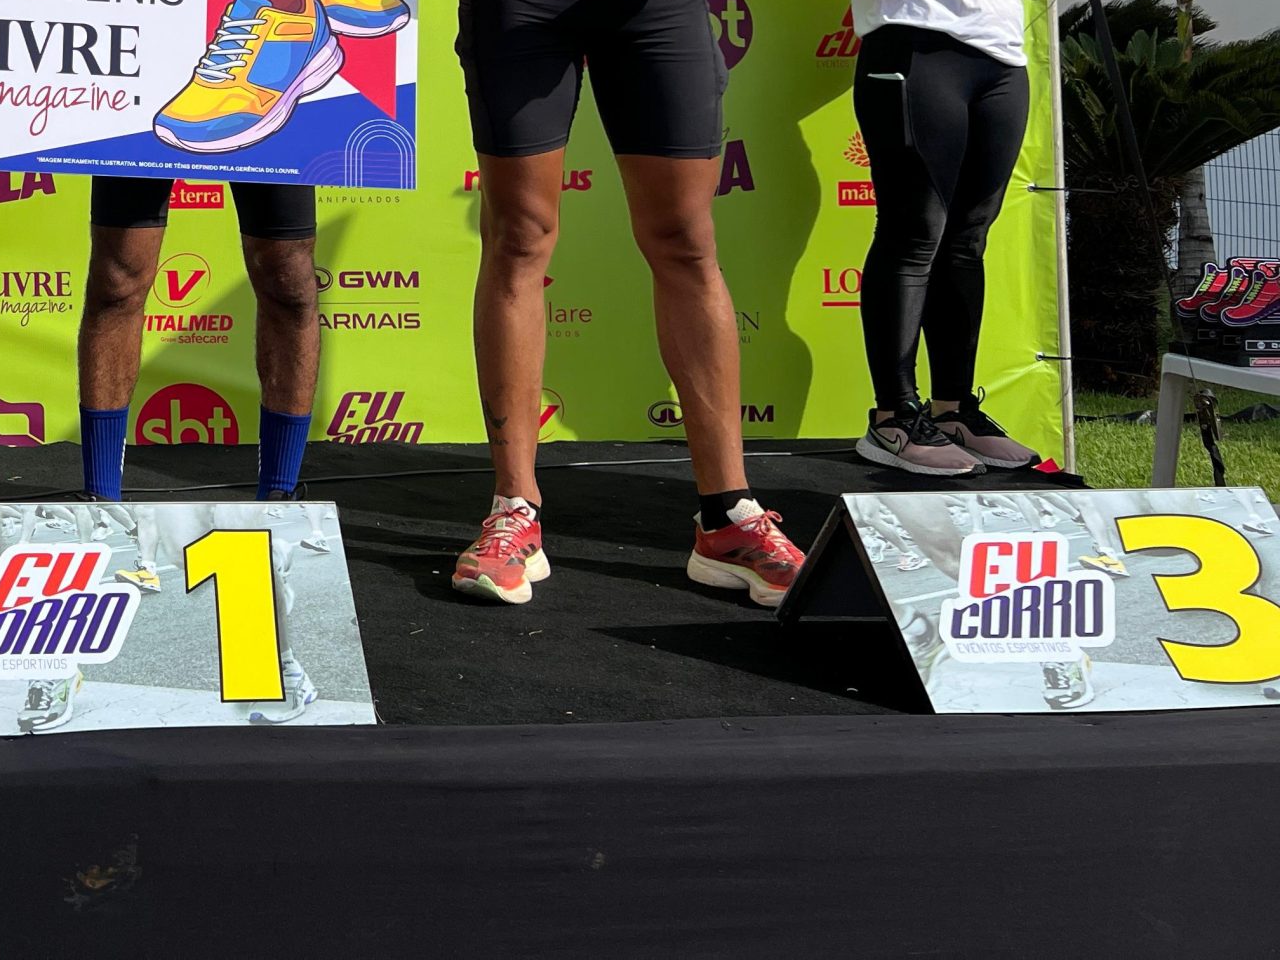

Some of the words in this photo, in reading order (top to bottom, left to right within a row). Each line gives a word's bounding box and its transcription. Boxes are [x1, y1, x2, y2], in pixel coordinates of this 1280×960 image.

[62, 157, 99, 166] MERAMENTE
[138, 161, 164, 169] MODELO
[191, 163, 219, 171] DEFINIDO
[219, 164, 235, 172] PELA
[180, 189, 221, 203] terra
[338, 271, 420, 289] GWM
[319, 313, 420, 329] ARMAIS
[178, 333, 229, 344] safecare
[970, 540, 1058, 599] EU
[1115, 513, 1280, 683] 3
[184, 528, 286, 703] 1
[950, 579, 1104, 639] CORRO
[957, 642, 1003, 655] EVENTOS
[1007, 642, 1072, 654] ESPORTIVOS
[1, 658, 68, 671] ESPORTIVOS
